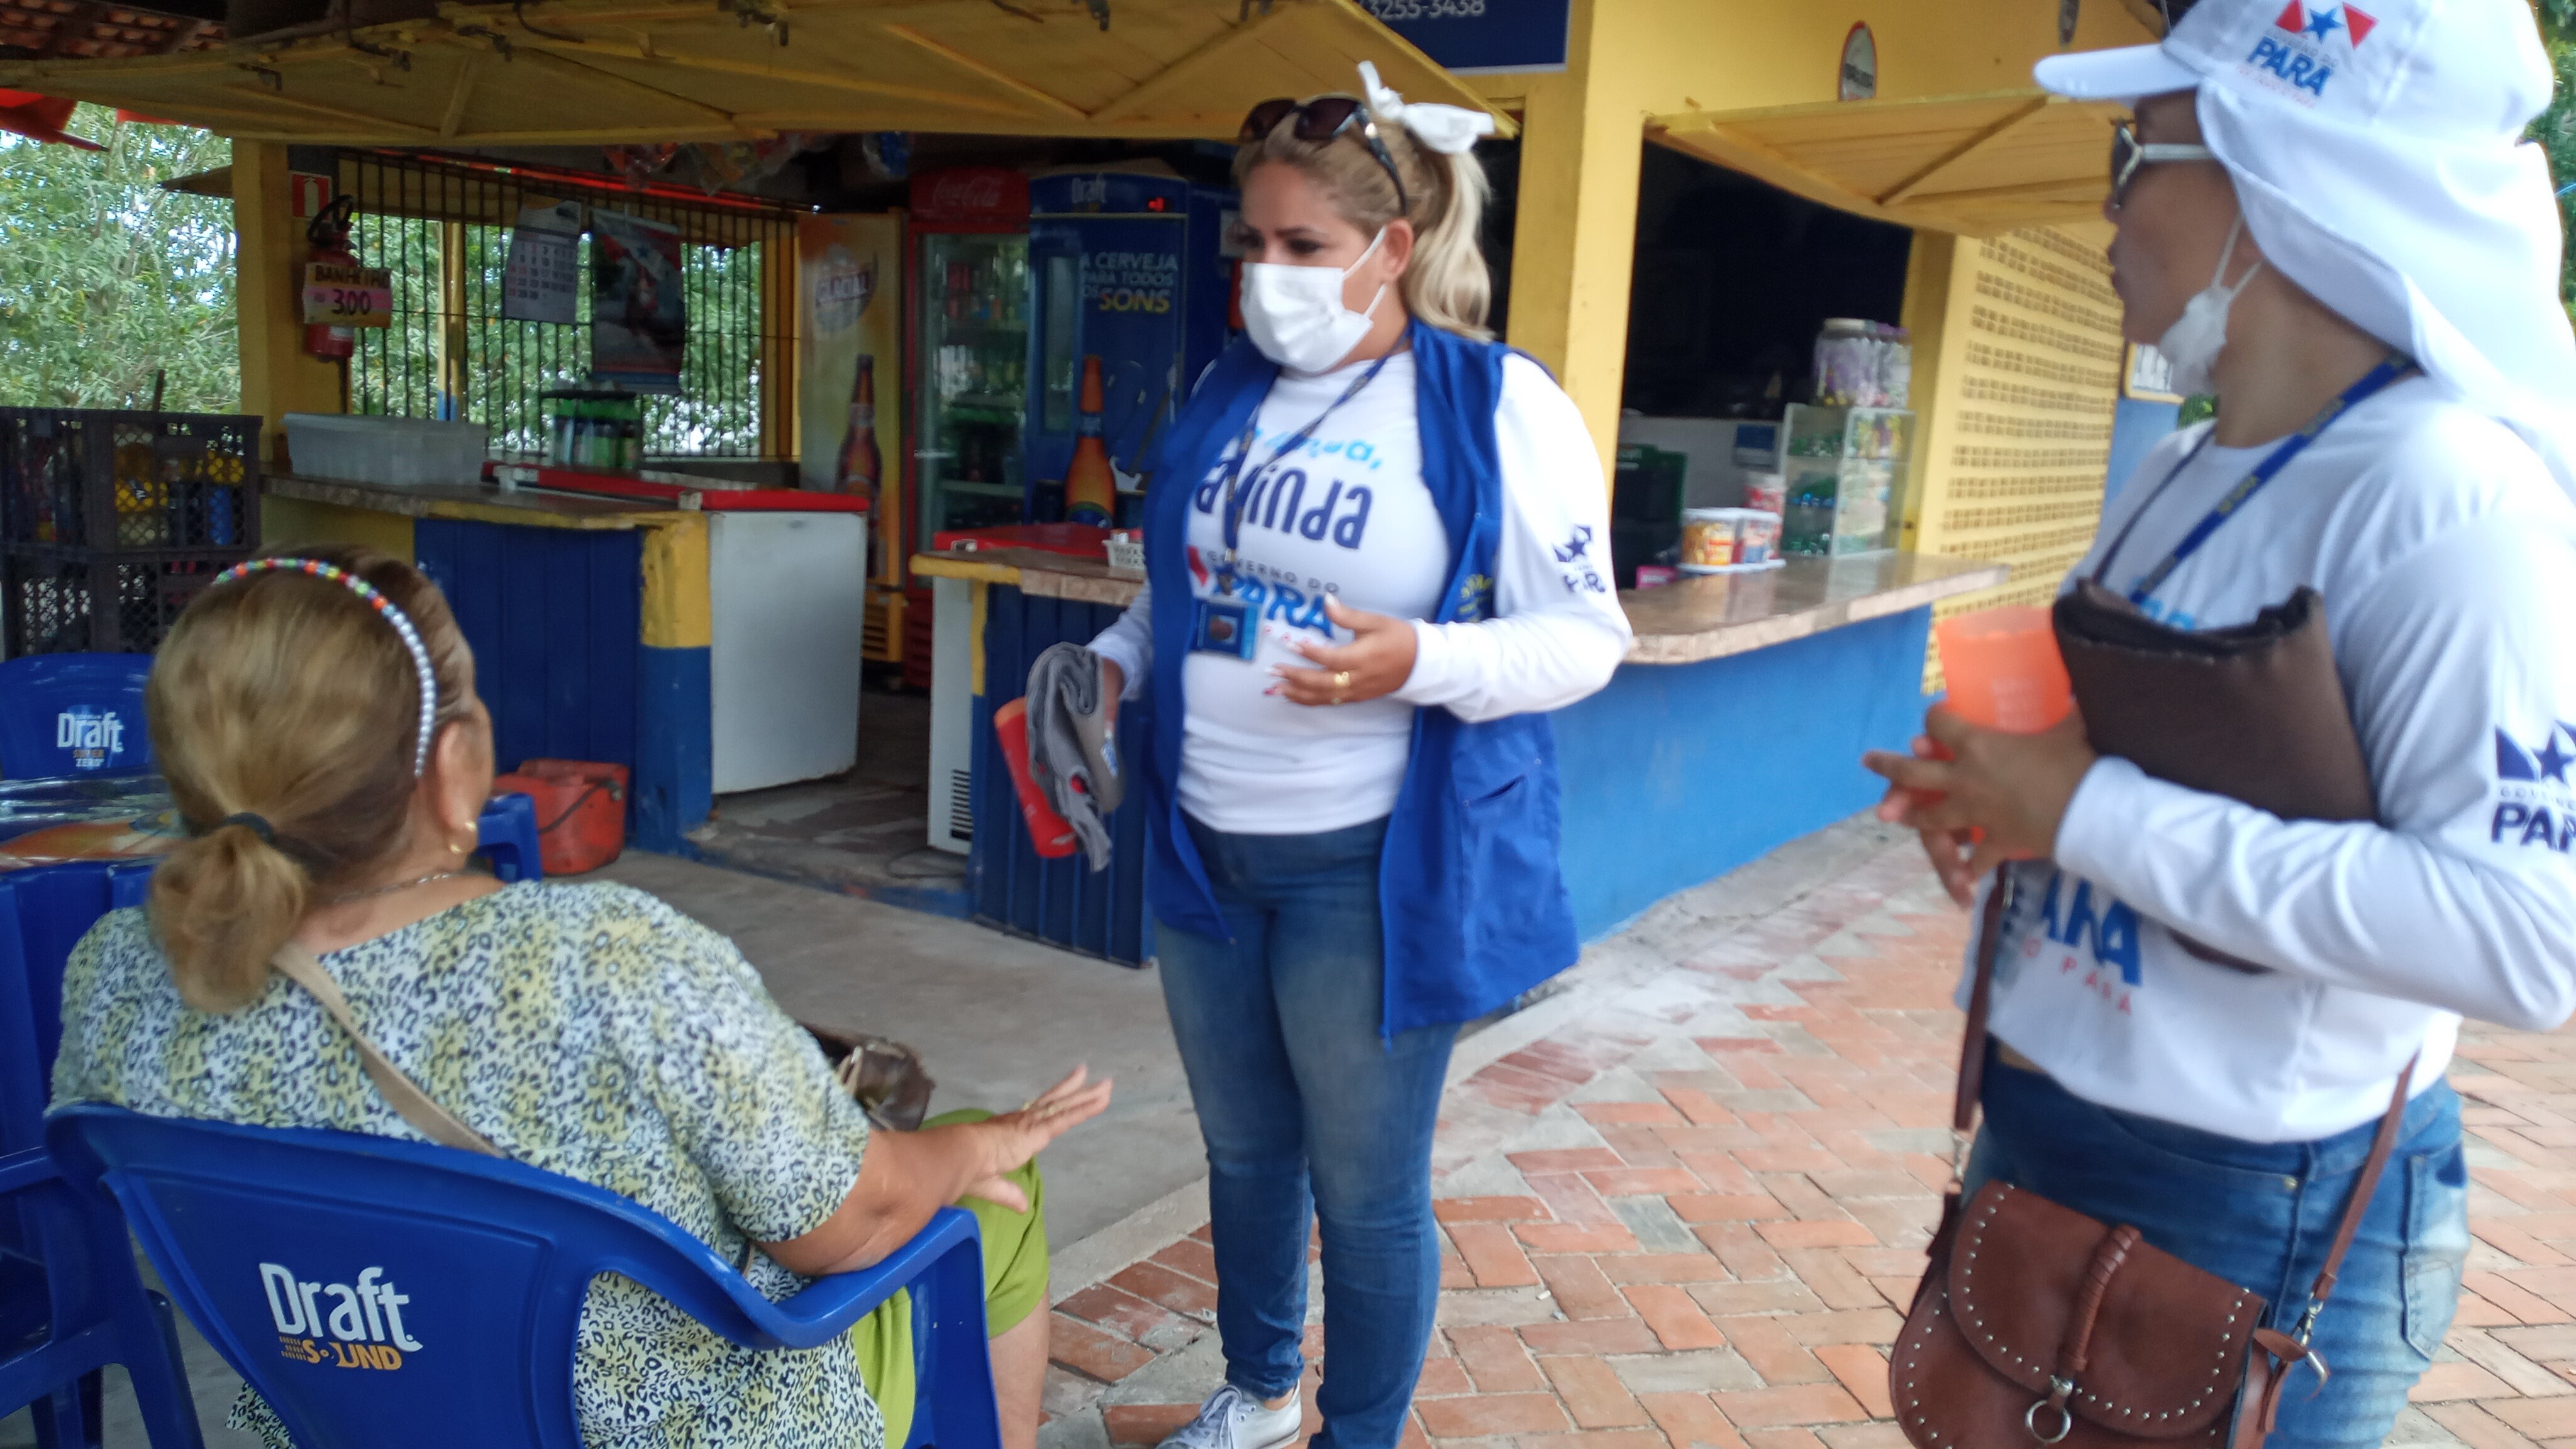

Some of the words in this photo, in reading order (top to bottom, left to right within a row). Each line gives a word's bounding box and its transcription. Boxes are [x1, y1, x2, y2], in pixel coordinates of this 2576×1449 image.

[1096, 252, 1178, 271] CERVEJA
[1099, 287, 1170, 314] SONS
[57, 711, 125, 753] Draft
[259, 1263, 423, 1352] Draft
